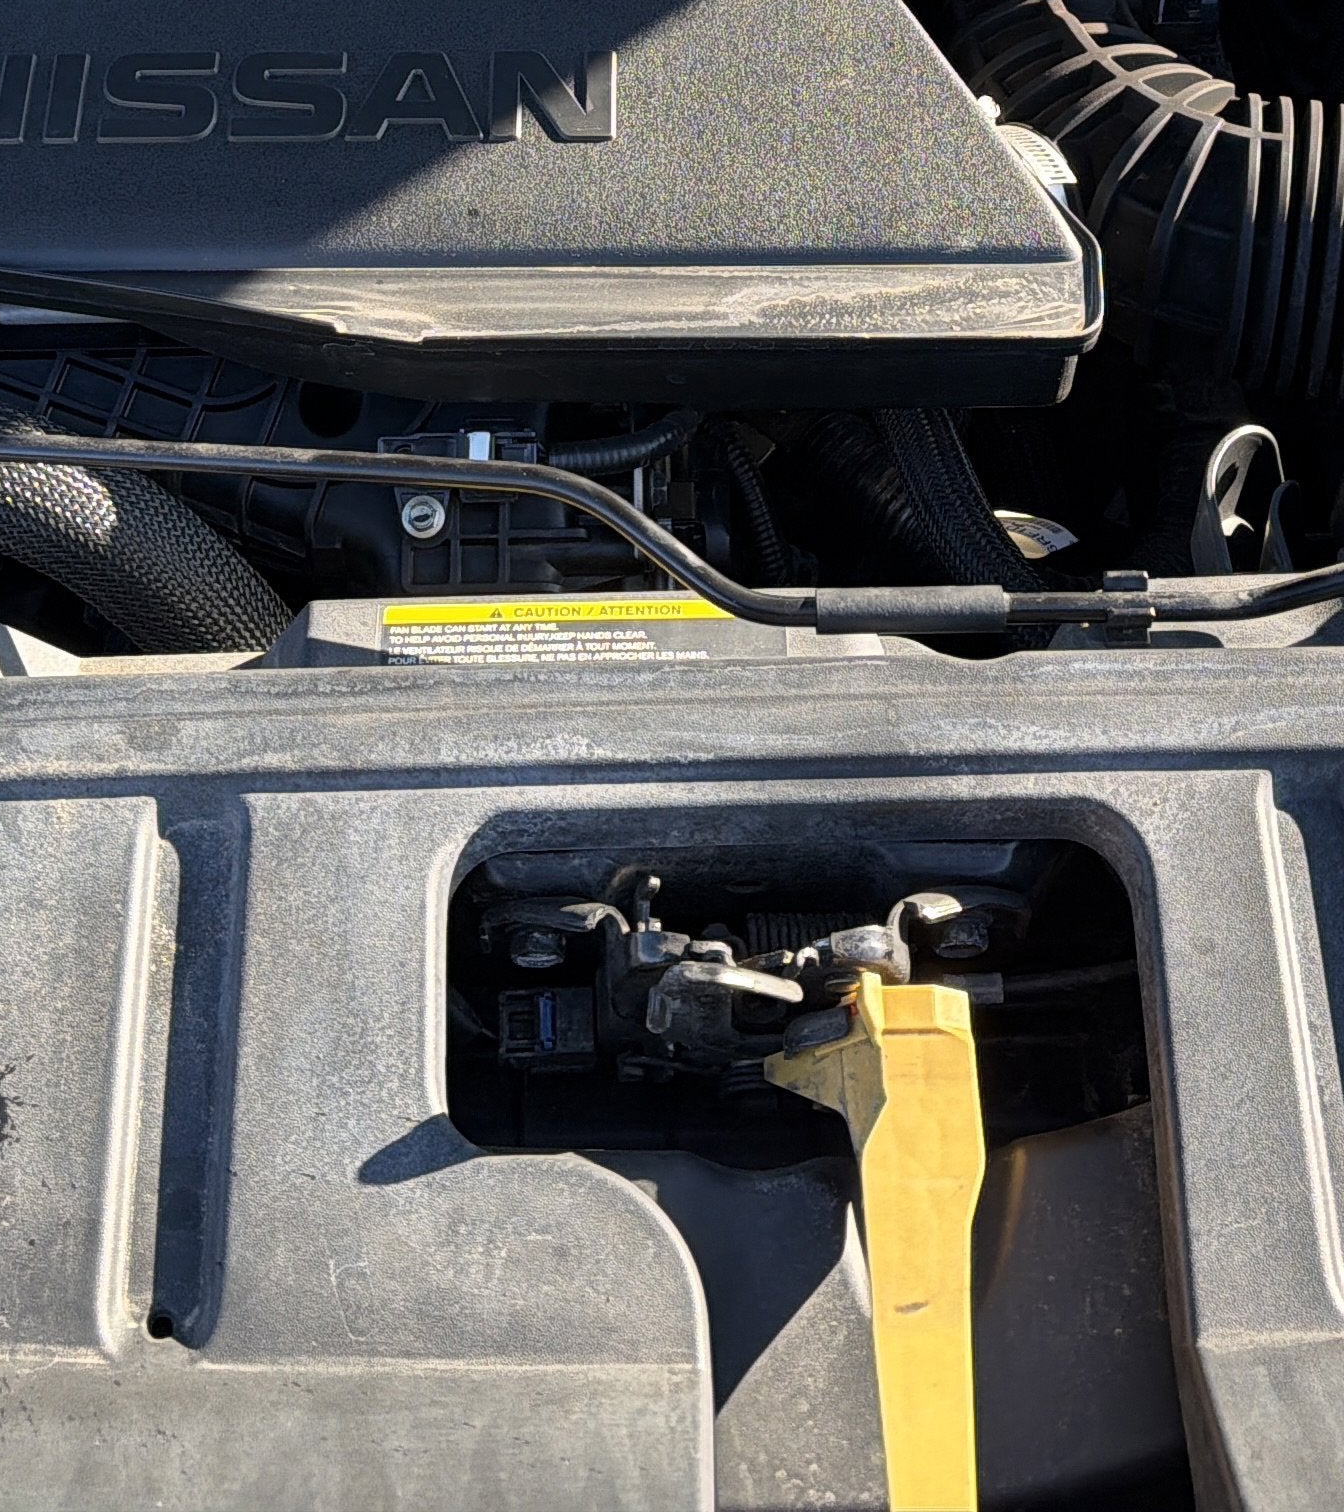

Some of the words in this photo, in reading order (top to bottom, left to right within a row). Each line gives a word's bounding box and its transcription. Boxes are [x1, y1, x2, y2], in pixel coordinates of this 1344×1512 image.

[513, 606, 581, 618] CAUTION
[600, 604, 682, 616] ATTENTION
[389, 626, 410, 635] FAN
[410, 625, 443, 634] BLADE
[444, 624, 466, 633] CAN
[467, 623, 498, 633] START
[498, 623, 512, 632] AT
[512, 622, 534, 631] ANY
[389, 635, 404, 644] TO
[404, 635, 431, 644] HELP
[431, 634, 462, 643] AVOID
[463, 633, 516, 642] PERSONAL
[576, 631, 612, 640] HANDS
[401, 645, 465, 655] VENTILATEUR
[466, 644, 504, 653] RISQUE
[505, 643, 519, 652] DE
[585, 642, 611, 651] TOUT
[388, 656, 417, 665] POUR
[452, 655, 485, 664] TOUTE
[540, 653, 555, 662] NE
[556, 653, 576, 662] PAS
[577, 652, 592, 662] EN
[592, 651, 655, 661] APPROCHER
[656, 651, 675, 660] LES
